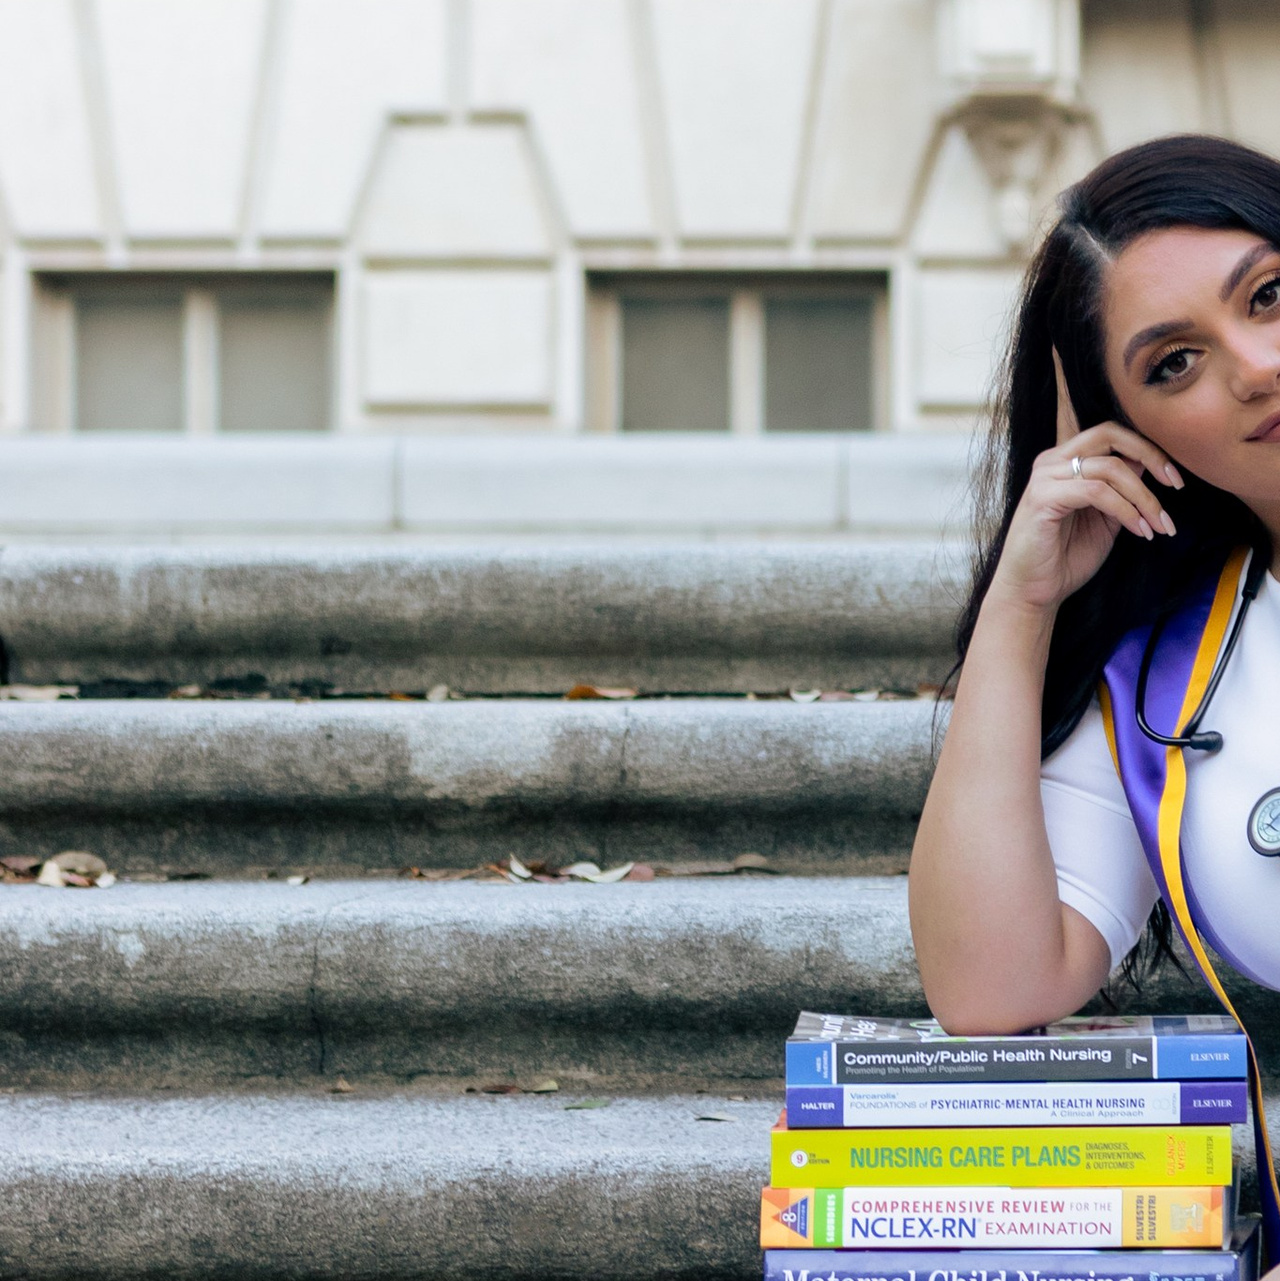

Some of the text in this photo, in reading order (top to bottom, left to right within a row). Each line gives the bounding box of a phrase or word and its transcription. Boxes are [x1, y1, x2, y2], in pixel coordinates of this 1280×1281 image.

[843, 1047, 1112, 1066] Community/Public Health Nursing
[1132, 1052, 1148, 1065] 7
[1190, 1053, 1230, 1062] ELSEVIER
[845, 1065, 985, 1076] Promoting the Health of Populations
[801, 1102, 835, 1110] HALTER
[850, 1098, 1145, 1110] FOUNDATIONS of PSYCHIATRIC-MENTAL HEALTH NURSING
[1193, 1099, 1232, 1108] ELSEVIER
[1098, 1110, 1144, 1118] Approach
[1086, 1142, 1130, 1152] DIAGNOSES,
[796, 1154, 803, 1163] 9
[850, 1145, 1081, 1168] NURSING CARE PLANS
[1086, 1152, 1146, 1161] INTERVENTIONS,
[1178, 1140, 1186, 1170] MYERS
[1086, 1161, 1135, 1169] & OUTCOMES
[851, 1200, 1112, 1213] COMPREHENSIVE REVIEW FOR THE
[782, 1213, 797, 1223] 8
[826, 1194, 837, 1243] SAUNDERS
[1135, 1195, 1144, 1241] SILVESTRI
[1148, 1195, 1156, 1241] SILVESTRI
[985, 1221, 1112, 1236] EXAMINATION
